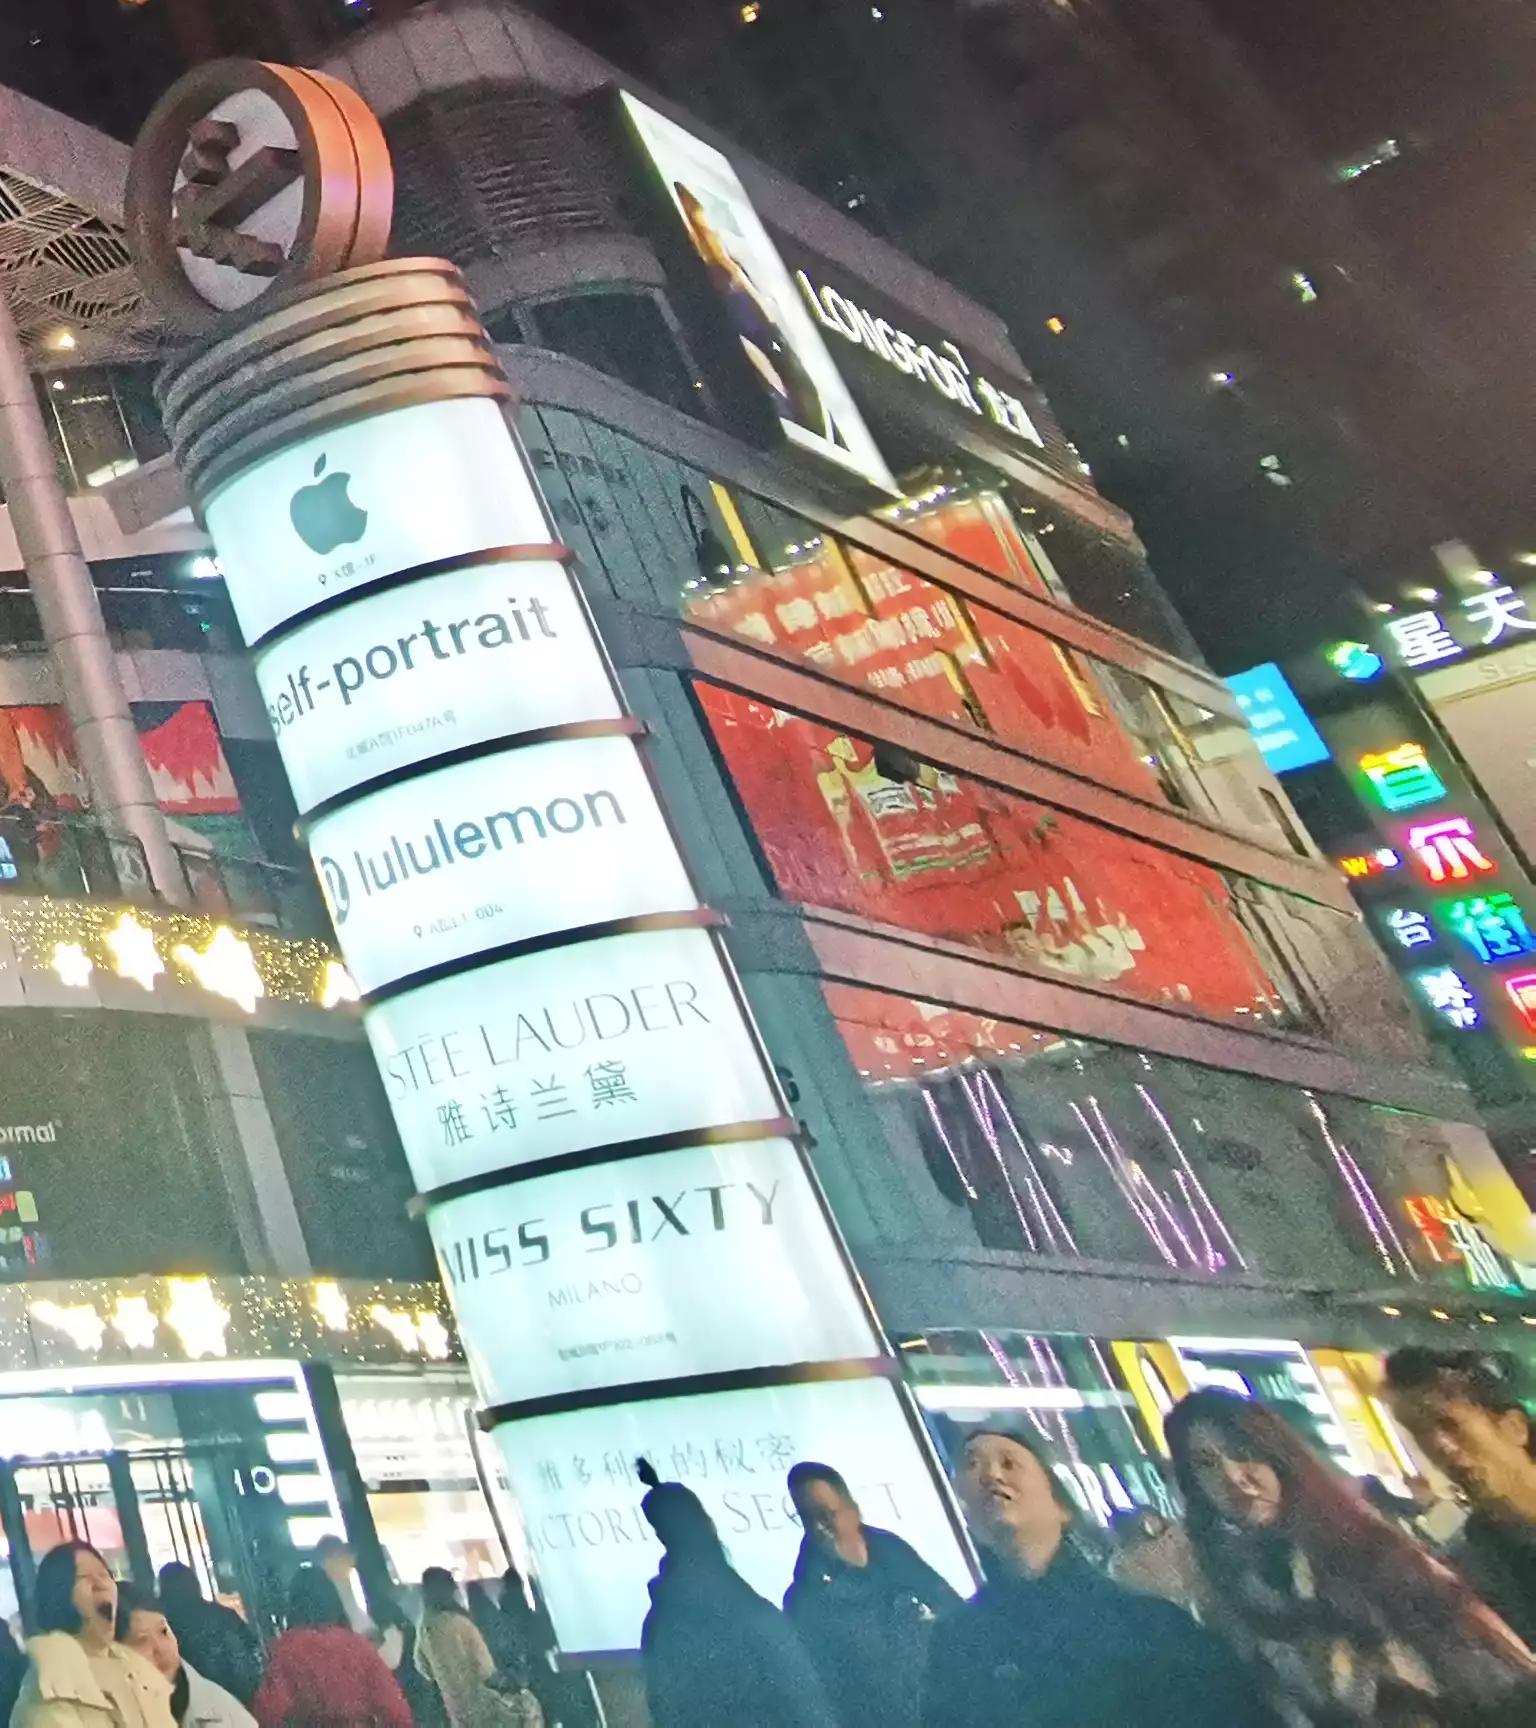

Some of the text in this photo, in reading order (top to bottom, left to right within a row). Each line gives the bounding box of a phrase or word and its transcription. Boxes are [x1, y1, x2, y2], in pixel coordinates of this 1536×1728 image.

[796, 269, 983, 416] LONGFOR
[269, 596, 559, 736] self-portrait
[353, 790, 628, 897] lululemon
[480, 980, 711, 1066] LAUDER
[437, 1059, 639, 1147] 雅诗兰黛
[579, 1179, 779, 1253] SIXTY
[547, 1272, 643, 1309] MILANO
